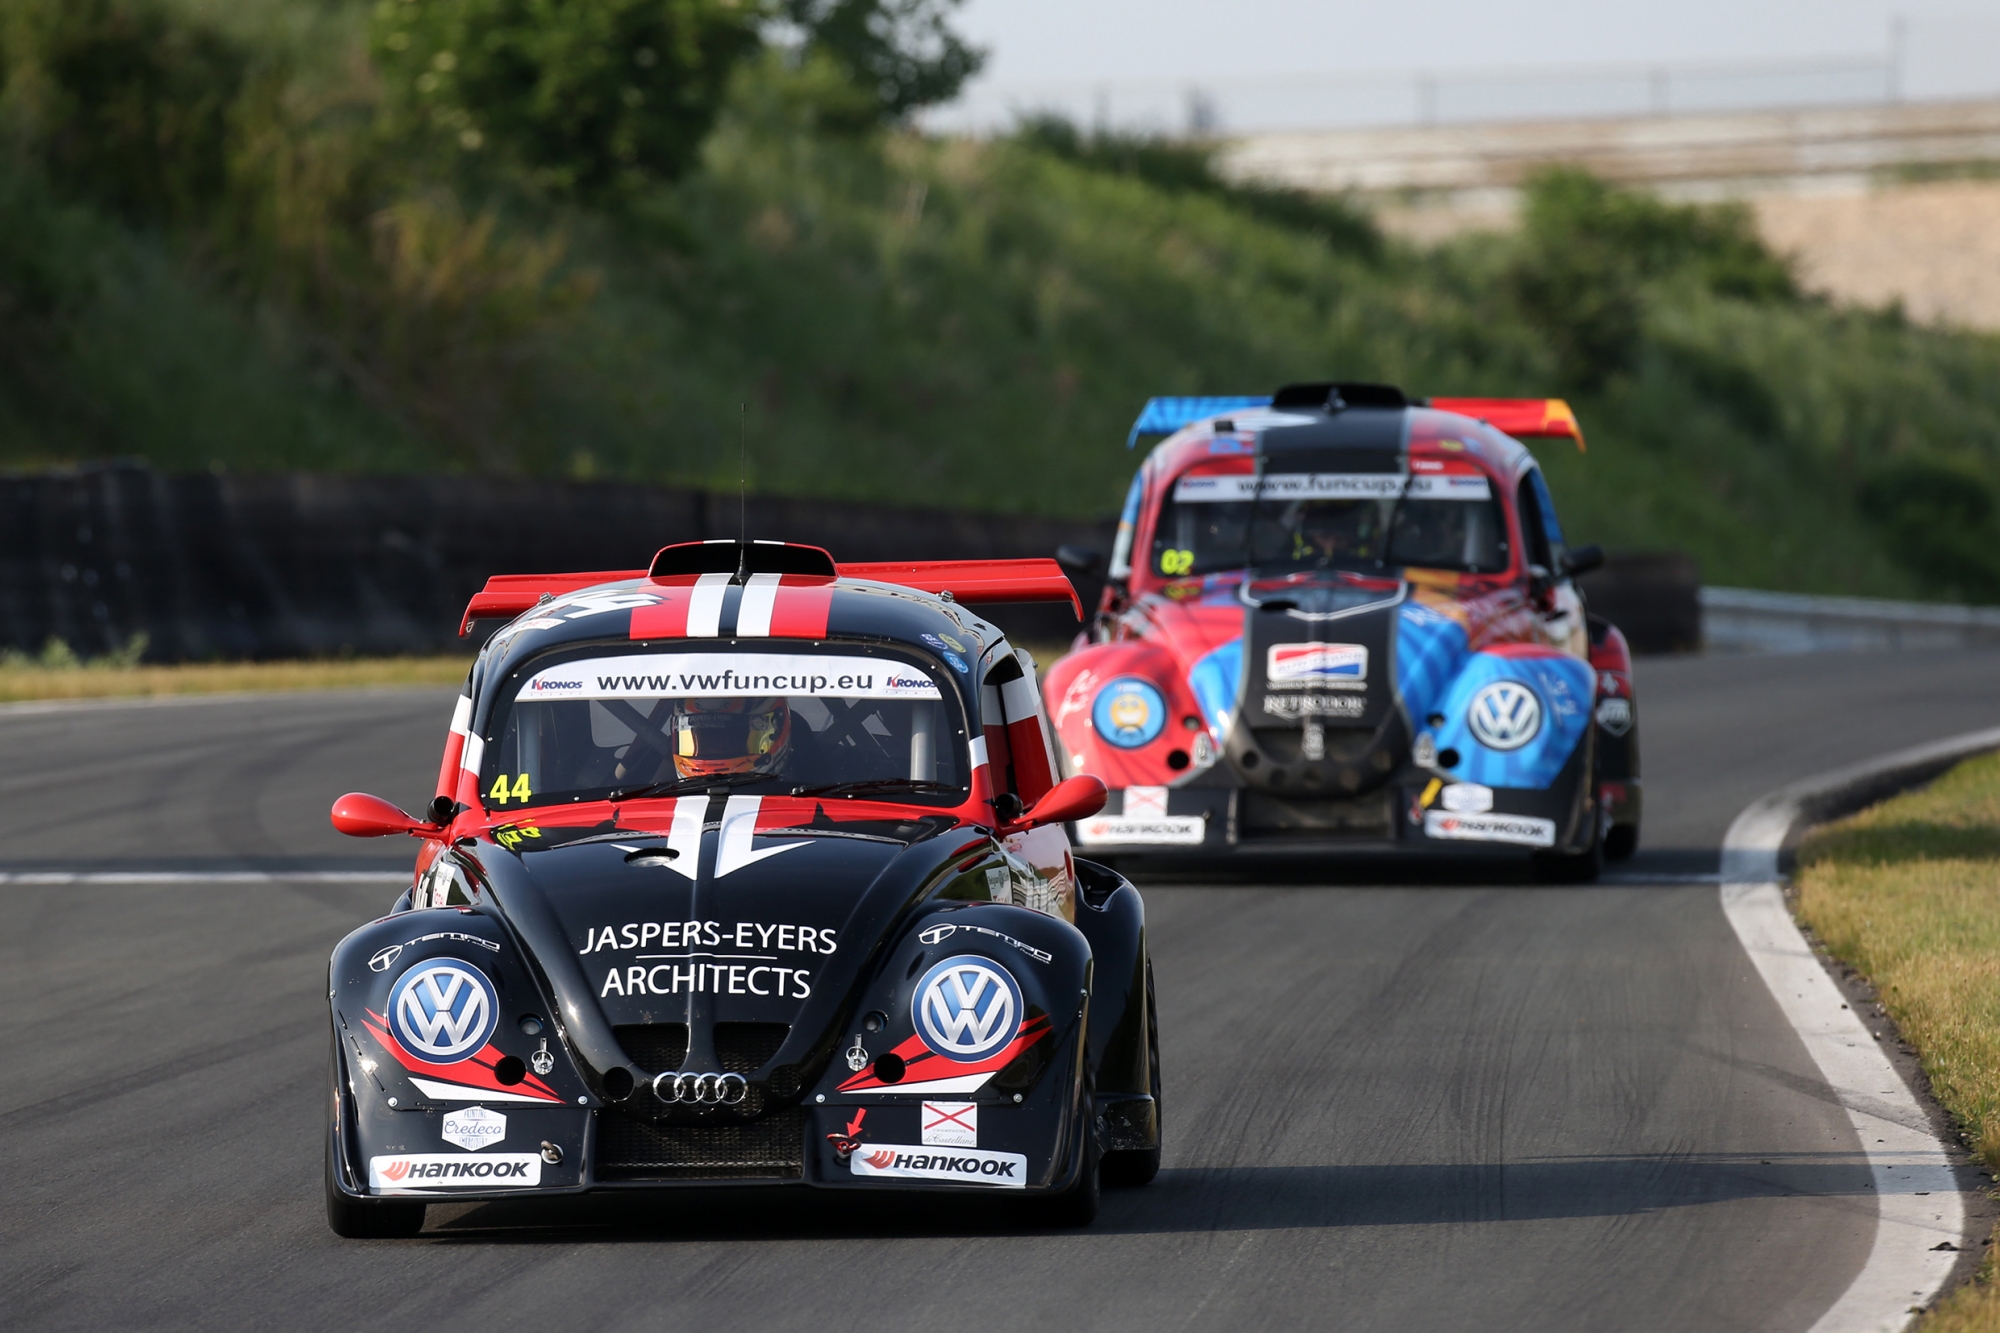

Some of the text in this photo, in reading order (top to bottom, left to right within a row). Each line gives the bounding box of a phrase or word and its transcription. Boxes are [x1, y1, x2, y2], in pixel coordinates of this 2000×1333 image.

[1160, 549, 1195, 575] 02
[531, 676, 583, 691] KRONOS
[597, 669, 873, 693] www.vwfuncup.eu
[489, 773, 532, 804] 44
[579, 920, 838, 955] JASPERS-EYERS
[600, 963, 812, 999] ARCHITECTS
[444, 1120, 503, 1135] Credeco
